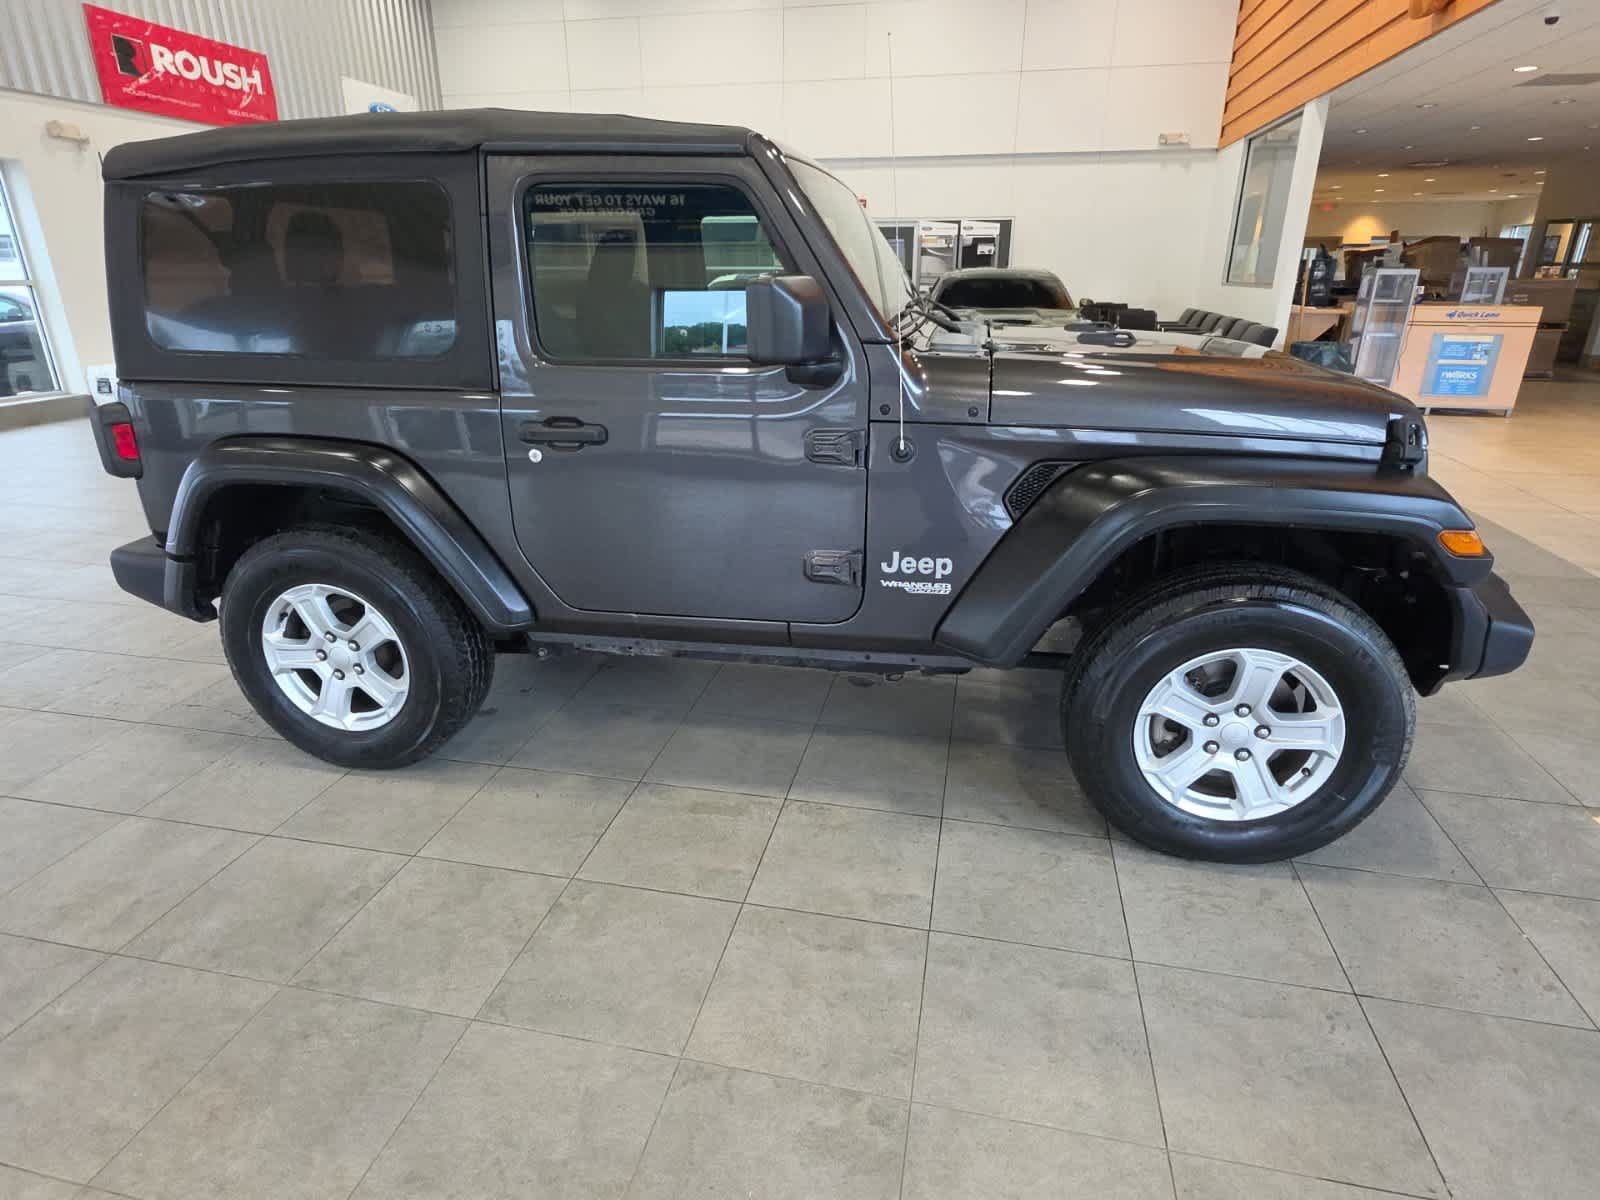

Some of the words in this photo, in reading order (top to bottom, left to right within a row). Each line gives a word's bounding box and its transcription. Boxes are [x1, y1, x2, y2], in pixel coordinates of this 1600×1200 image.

[150, 43, 263, 95] ROUSH
[880, 551, 953, 579] Jeep
[880, 580, 951, 590] WRANGLER
